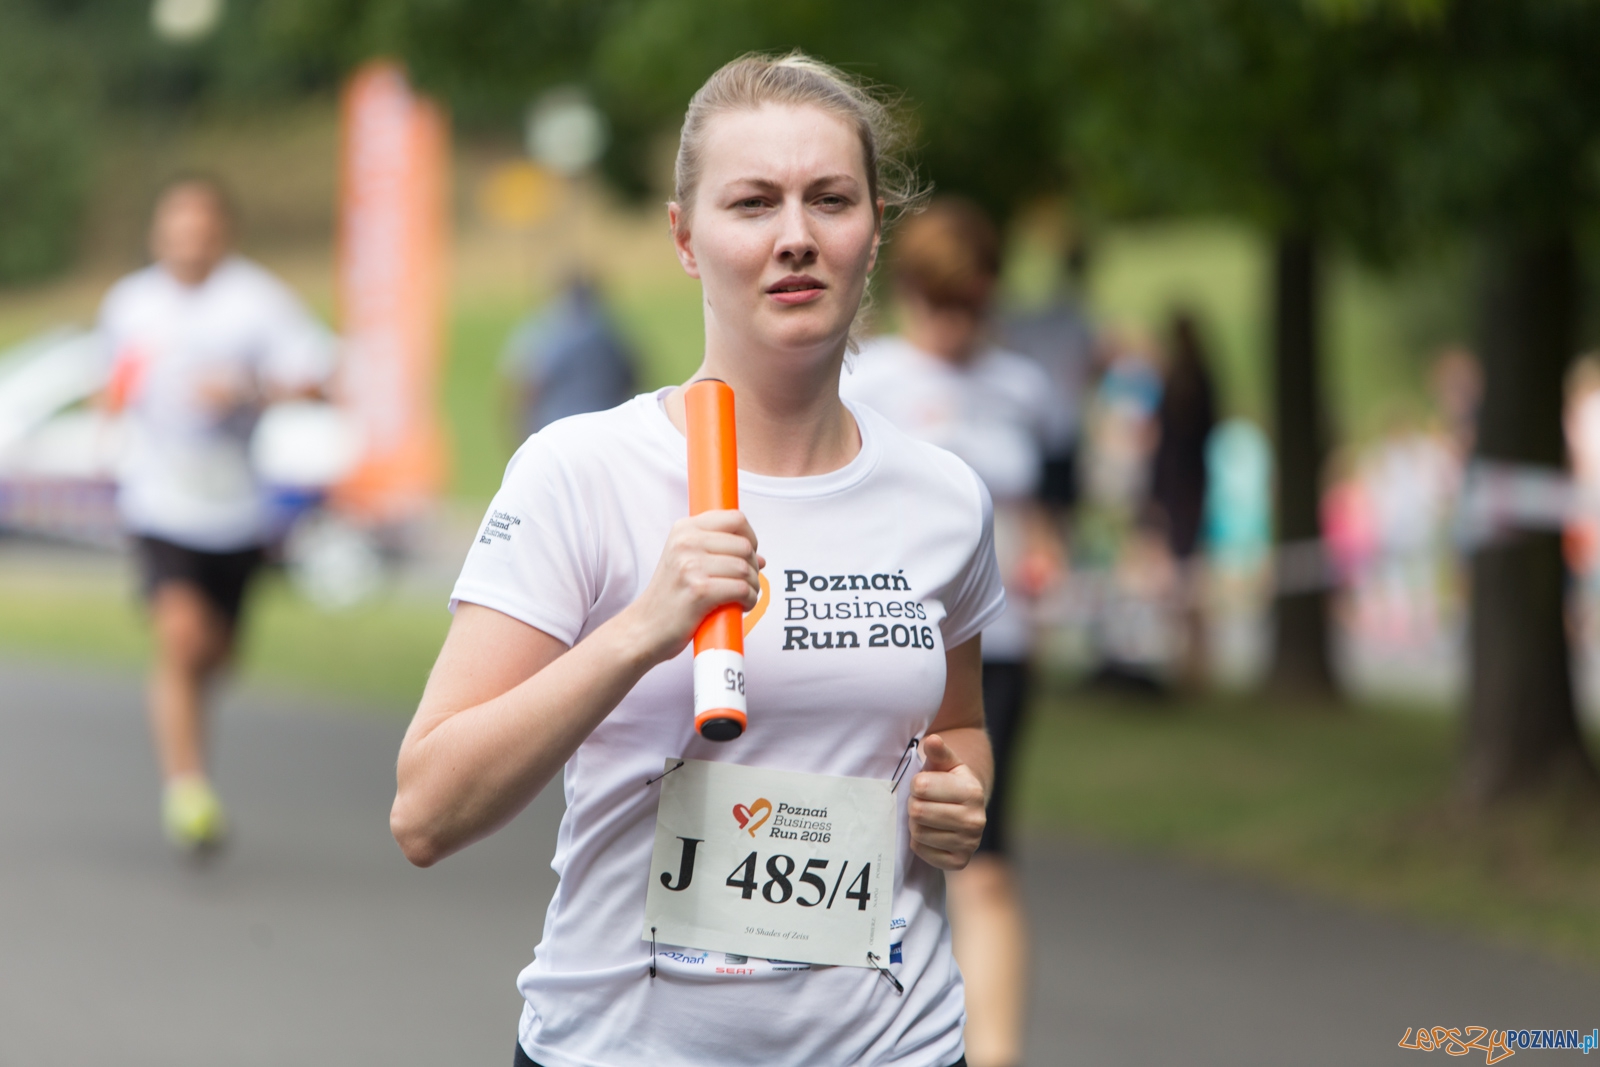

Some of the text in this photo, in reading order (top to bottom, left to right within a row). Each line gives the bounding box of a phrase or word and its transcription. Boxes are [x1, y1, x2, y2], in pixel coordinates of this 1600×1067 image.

[488, 519, 510, 530] Poland
[480, 536, 491, 544] Run
[484, 527, 512, 541] Business
[784, 569, 911, 592] Poznań
[784, 596, 927, 621] Business
[782, 624, 934, 650] Run 2016
[777, 802, 828, 818] Poznań
[773, 815, 832, 831] Business
[769, 827, 832, 843] Run 2016
[660, 836, 871, 911] J 485/4
[744, 926, 810, 940] 50 Shades of Zeiss
[715, 967, 756, 975] SEAT
